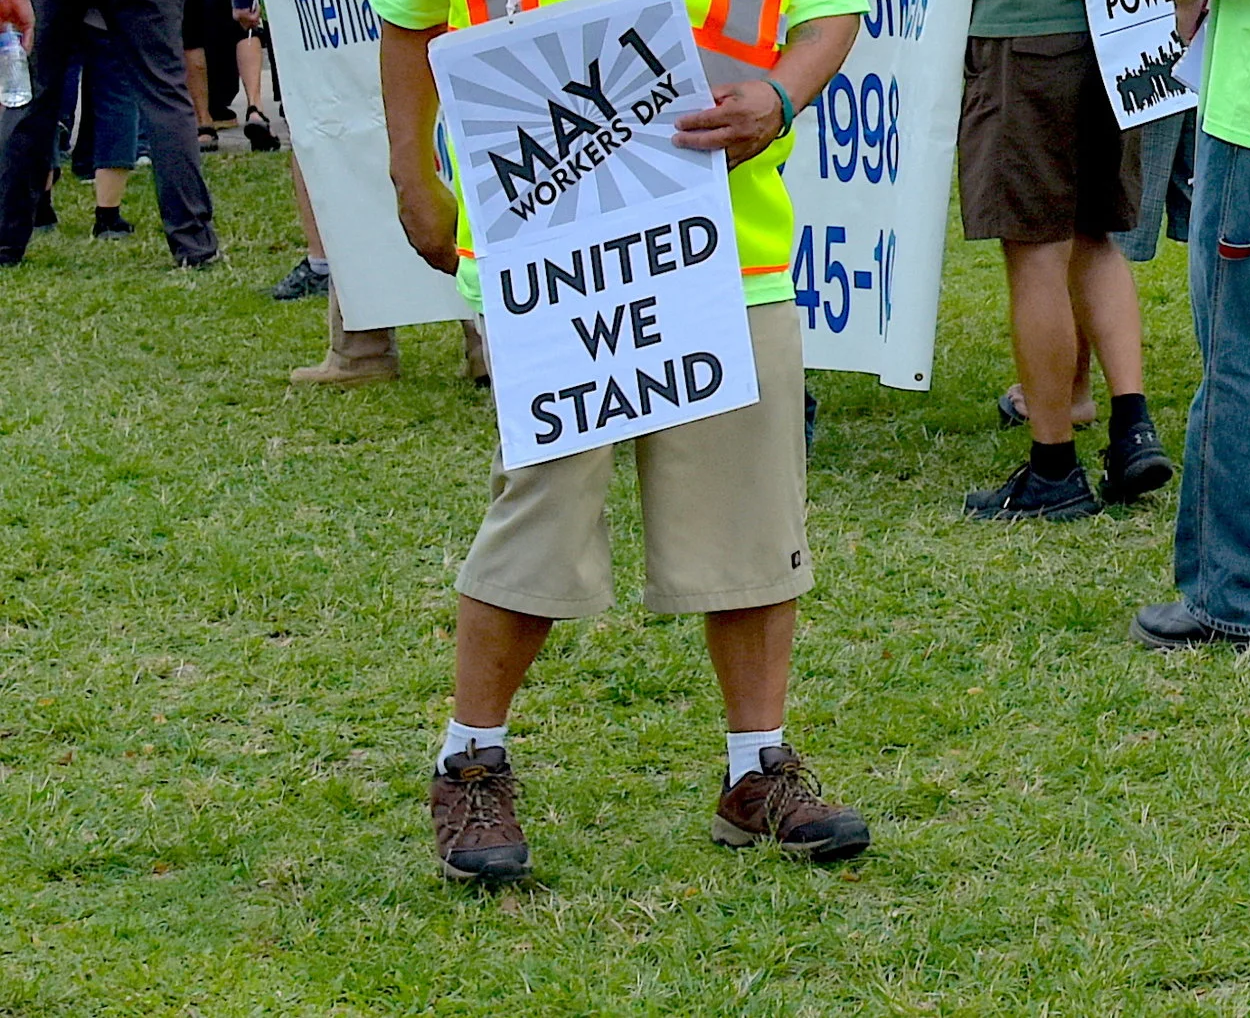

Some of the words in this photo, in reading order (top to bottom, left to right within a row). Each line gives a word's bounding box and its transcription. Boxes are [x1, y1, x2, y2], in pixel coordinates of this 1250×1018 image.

[488, 57, 618, 203] MAY
[618, 27, 667, 78] 1
[509, 118, 632, 222] WORKERS
[630, 73, 680, 126] DAY
[808, 72, 900, 186] 1998
[500, 216, 718, 315] UNITED
[571, 296, 661, 362] WE
[531, 352, 723, 445] STAND
